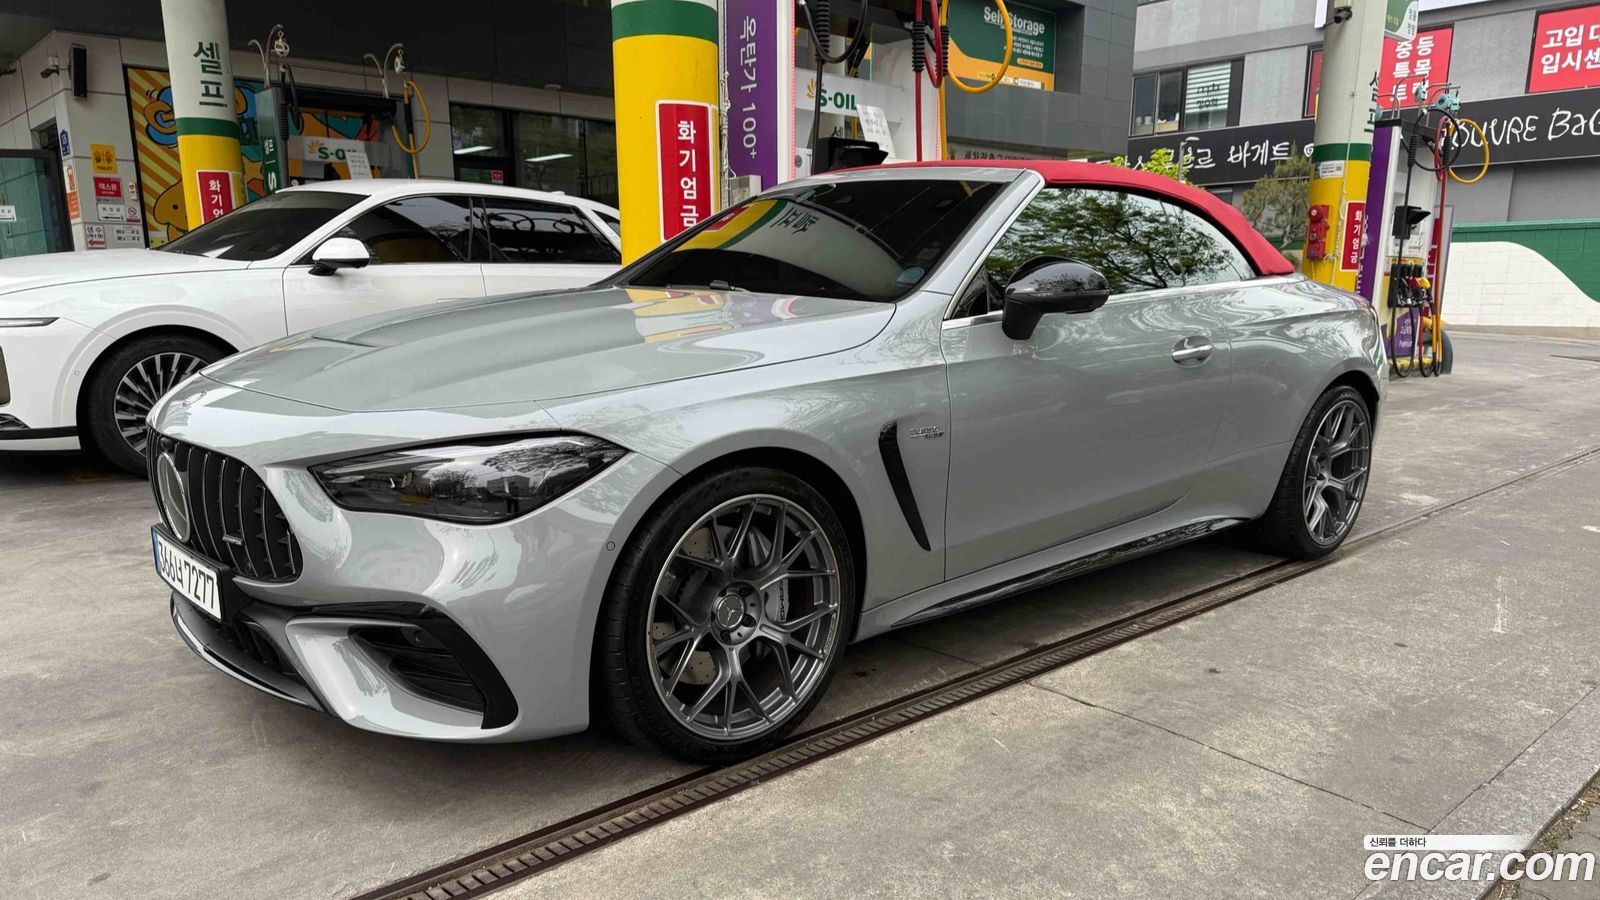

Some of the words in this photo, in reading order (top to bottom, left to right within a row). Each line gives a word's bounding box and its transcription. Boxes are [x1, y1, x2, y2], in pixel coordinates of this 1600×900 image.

[740, 16, 757, 93] 옥탄가
[1542, 25, 1585, 49] 고입
[193, 41, 228, 108] 셀프
[318, 146, 357, 160] S-O
[742, 103, 757, 159] 100+
[1227, 140, 1290, 168] 바게트
[677, 120, 699, 228] 화기엄금
[158, 541, 184, 588] 366너
[183, 560, 215, 610] 7277
